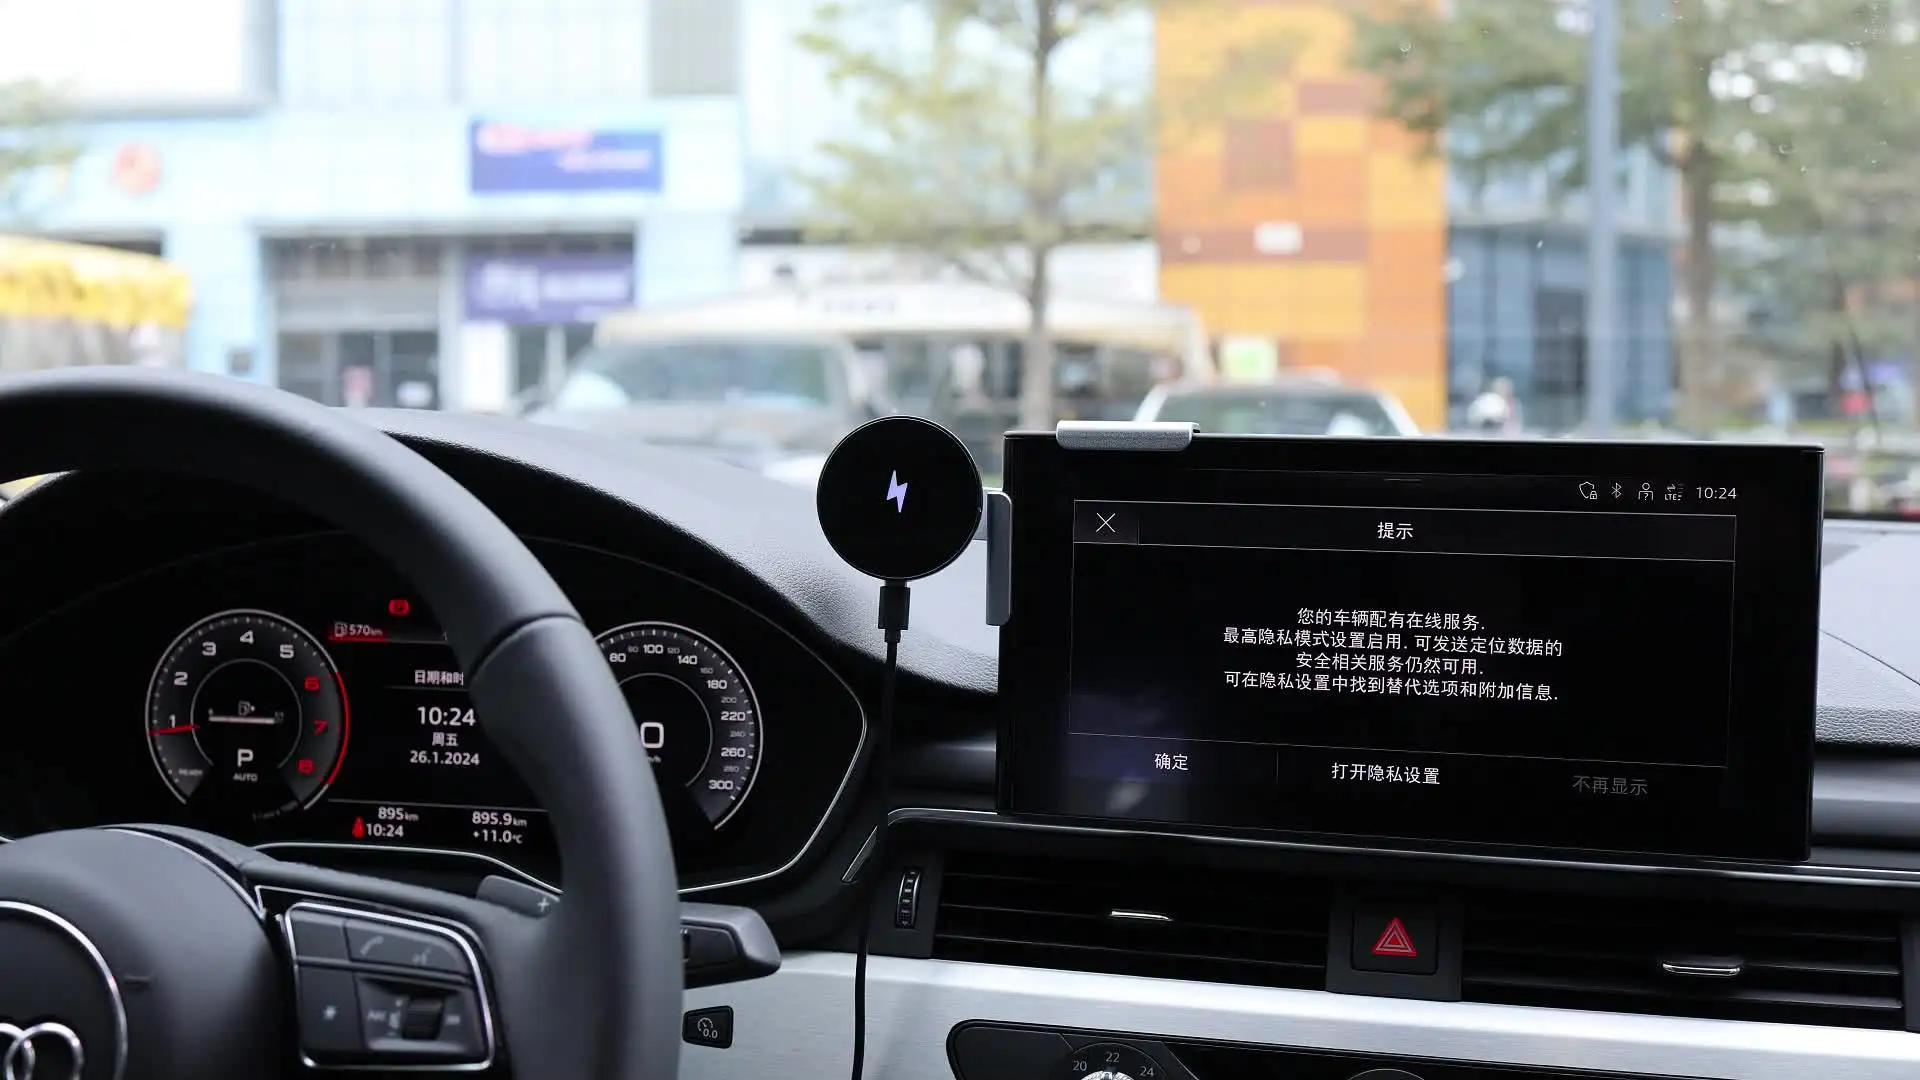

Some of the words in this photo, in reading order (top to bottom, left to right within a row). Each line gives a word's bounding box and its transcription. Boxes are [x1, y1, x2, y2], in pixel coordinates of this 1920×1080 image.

[1696, 487, 1737, 500] 10:24
[1377, 522, 1414, 540] 提示
[1297, 607, 1485, 631] 您的车辆配有在线服务.
[239, 630, 254, 645] 4
[202, 641, 217, 656] 3
[279, 644, 294, 659] 5
[643, 644, 664, 654] 100
[677, 655, 698, 665] 140
[1296, 651, 1484, 675] 安全相关服务仍然可用.
[173, 671, 188, 686] 2
[707, 679, 728, 690] 180
[1223, 670, 1559, 701] 可在隐私设置中找到替代选项和附加信息.
[169, 714, 176, 728] 1
[417, 706, 476, 727] 10:24
[720, 711, 746, 721] 220
[313, 720, 328, 735] 7
[431, 732, 459, 747] 周五
[237, 749, 254, 767] P
[410, 750, 480, 766] 26.1.2024
[720, 747, 746, 757] 260
[1154, 752, 1189, 772] 确定
[233, 773, 258, 782] AUTO
[1331, 762, 1441, 785] 打开隐私设置
[708, 780, 734, 790] 300
[1572, 776, 1649, 796] 不再显示
[366, 823, 404, 838] 10:24
[1105, 1051, 1120, 1063] 22
[1072, 1060, 1088, 1072] 20
[1140, 1065, 1154, 1077] 24
